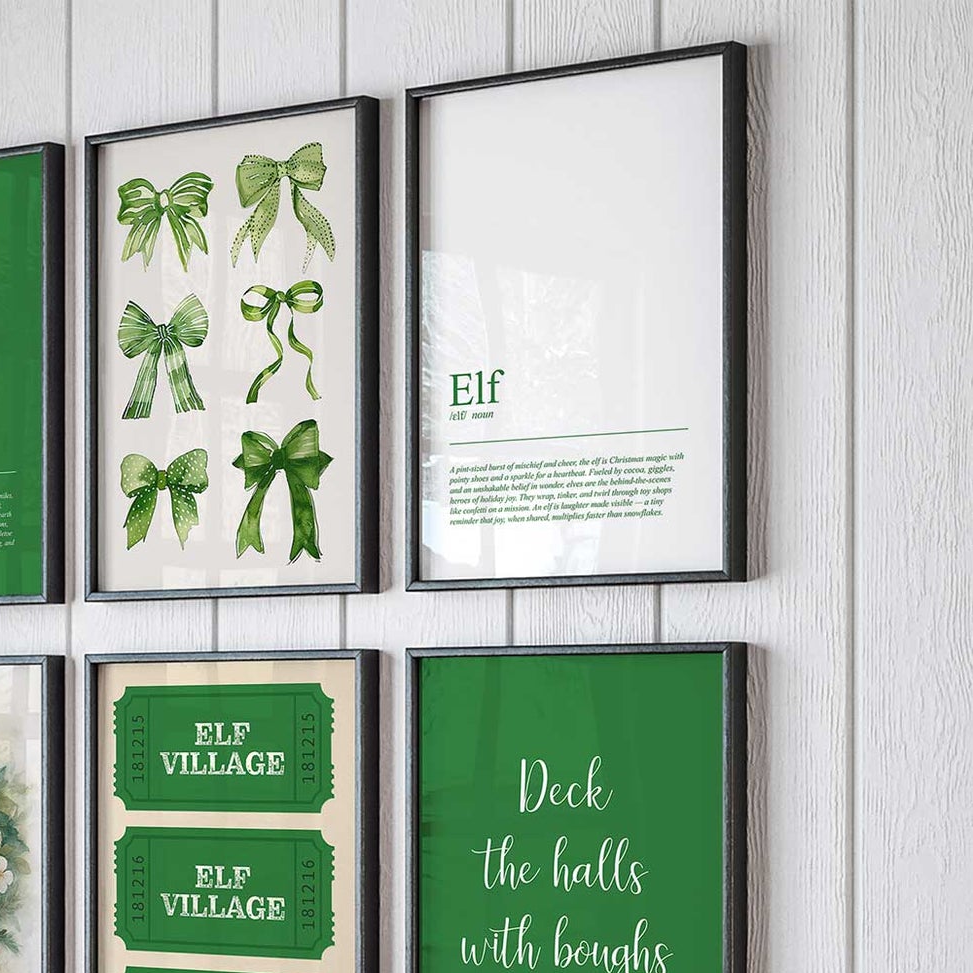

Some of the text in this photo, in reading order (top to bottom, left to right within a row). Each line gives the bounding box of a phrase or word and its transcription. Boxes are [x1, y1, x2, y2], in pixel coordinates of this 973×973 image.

[449, 368, 505, 407] Elf
[471, 410, 494, 420] noun
[449, 477, 470, 485] pointy
[471, 474, 489, 482] shoes
[510, 472, 535, 482] sparkle
[535, 472, 546, 481] for
[553, 469, 587, 478] heartbeat.
[589, 468, 612, 476] Fueled
[614, 467, 623, 476] by
[648, 465, 676, 474] giggles,
[455, 466, 487, 474] pint-sized
[507, 463, 515, 472] of
[515, 460, 543, 470] mischief
[544, 460, 558, 468] and
[558, 459, 578, 467] cheer,
[579, 458, 590, 466] the
[591, 457, 601, 467] elf
[610, 456, 644, 464] Christmas
[646, 454, 667, 463] magic
[669, 452, 685, 460] with
[449, 486, 672, 505] heroes of holiday joy. They wrap, tinker, and twirl through toy shops
[473, 484, 509, 493] unshakable
[511, 483, 531, 491] belief
[539, 481, 565, 489] wonder,
[566, 480, 583, 488] elves
[597, 478, 609, 486] the
[610, 476, 671, 485] behind-the-scenes
[449, 517, 478, 525] reminder
[480, 516, 493, 524] that
[526, 513, 550, 521] shared,
[551, 511, 584, 523] multiplies
[585, 511, 606, 521] faster
[607, 510, 623, 518] than
[624, 508, 664, 518] snowflakes.
[450, 507, 462, 515] like
[463, 506, 486, 515] confetti
[560, 501, 589, 511] laughter
[590, 500, 609, 508] made
[611, 499, 633, 507] visible
[650, 498, 664, 506] tiny
[194, 722, 251, 746] ELF
[132, 714, 145, 783] 181215
[302, 713, 315, 784] 181215
[160, 751, 285, 776] VILLAGE
[519, 755, 613, 813] Deck
[195, 865, 251, 889] ELF
[471, 834, 649, 895] the halls
[132, 855, 145, 922] 181216
[302, 859, 315, 931] 181216
[161, 894, 285, 921] VILLAGE
[461, 913, 542, 970] with
